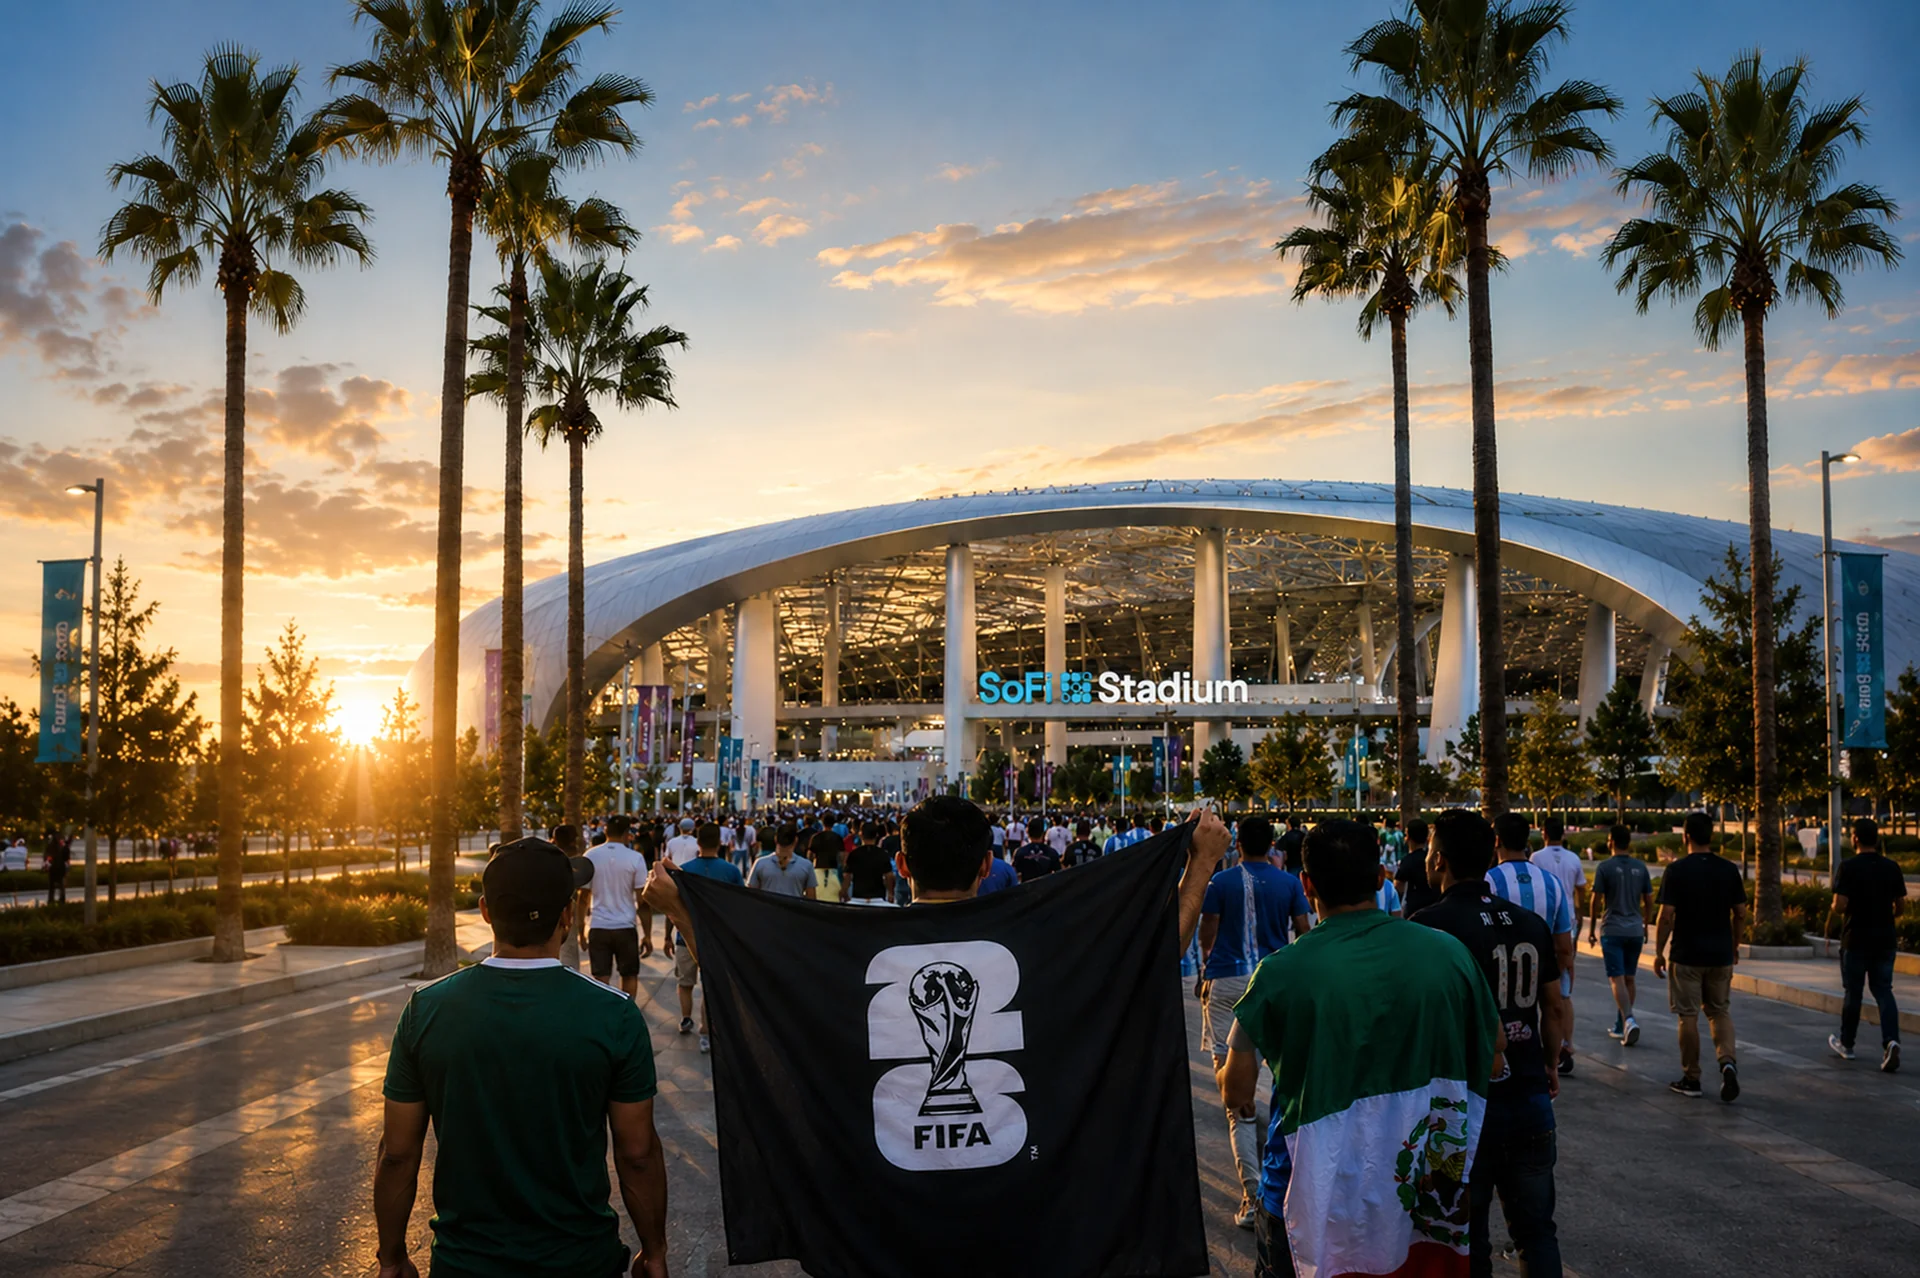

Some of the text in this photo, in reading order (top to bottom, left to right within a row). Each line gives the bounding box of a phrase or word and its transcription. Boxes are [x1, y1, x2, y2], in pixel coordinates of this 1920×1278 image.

[979, 671, 1249, 704] SoFi Stadium
[1492, 942, 1539, 1010] 10
[913, 1122, 992, 1150] FIFA
